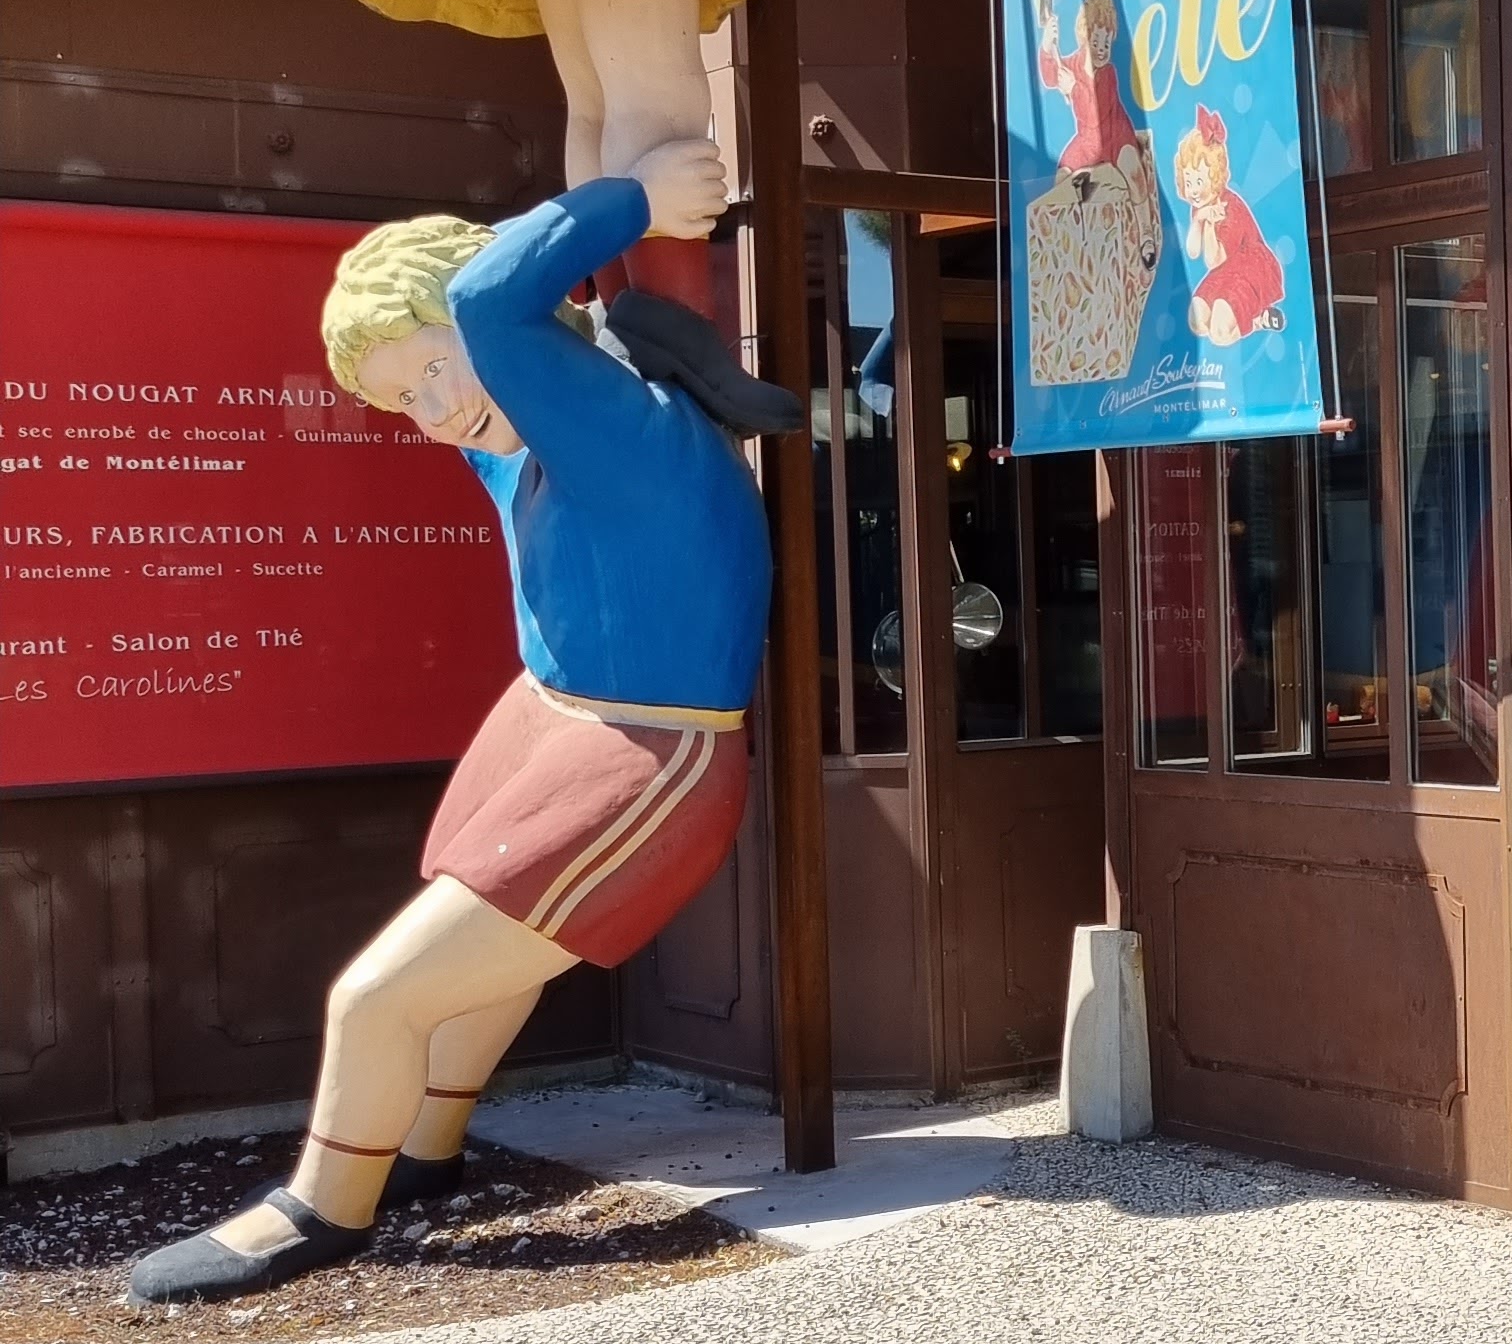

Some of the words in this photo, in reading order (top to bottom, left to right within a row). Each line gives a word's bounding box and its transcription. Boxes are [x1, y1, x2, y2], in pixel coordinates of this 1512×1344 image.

[4, 381, 48, 400] DU
[69, 382, 199, 404] NOUGAT
[217, 387, 337, 407] ARNAUD
[1153, 398, 1227, 414] MONTÉLIMAR
[18, 427, 53, 439] sec
[65, 425, 136, 440] enrobé
[148, 426, 171, 440] de
[183, 426, 266, 442] chocolat
[294, 429, 383, 443] Guimauve
[59, 455, 90, 470] de
[106, 455, 246, 471] Montélimar
[4, 526, 72, 547] URS,
[91, 526, 284, 544] FABRICATION
[302, 526, 319, 543] A
[335, 526, 492, 544] L'ANCIENNE
[5, 563, 111, 579] l'ancienne
[142, 562, 223, 578] Caramel
[252, 562, 324, 576] Sucette
[112, 633, 190, 652] Salon
[207, 631, 239, 649] de
[256, 628, 304, 647] Thé
